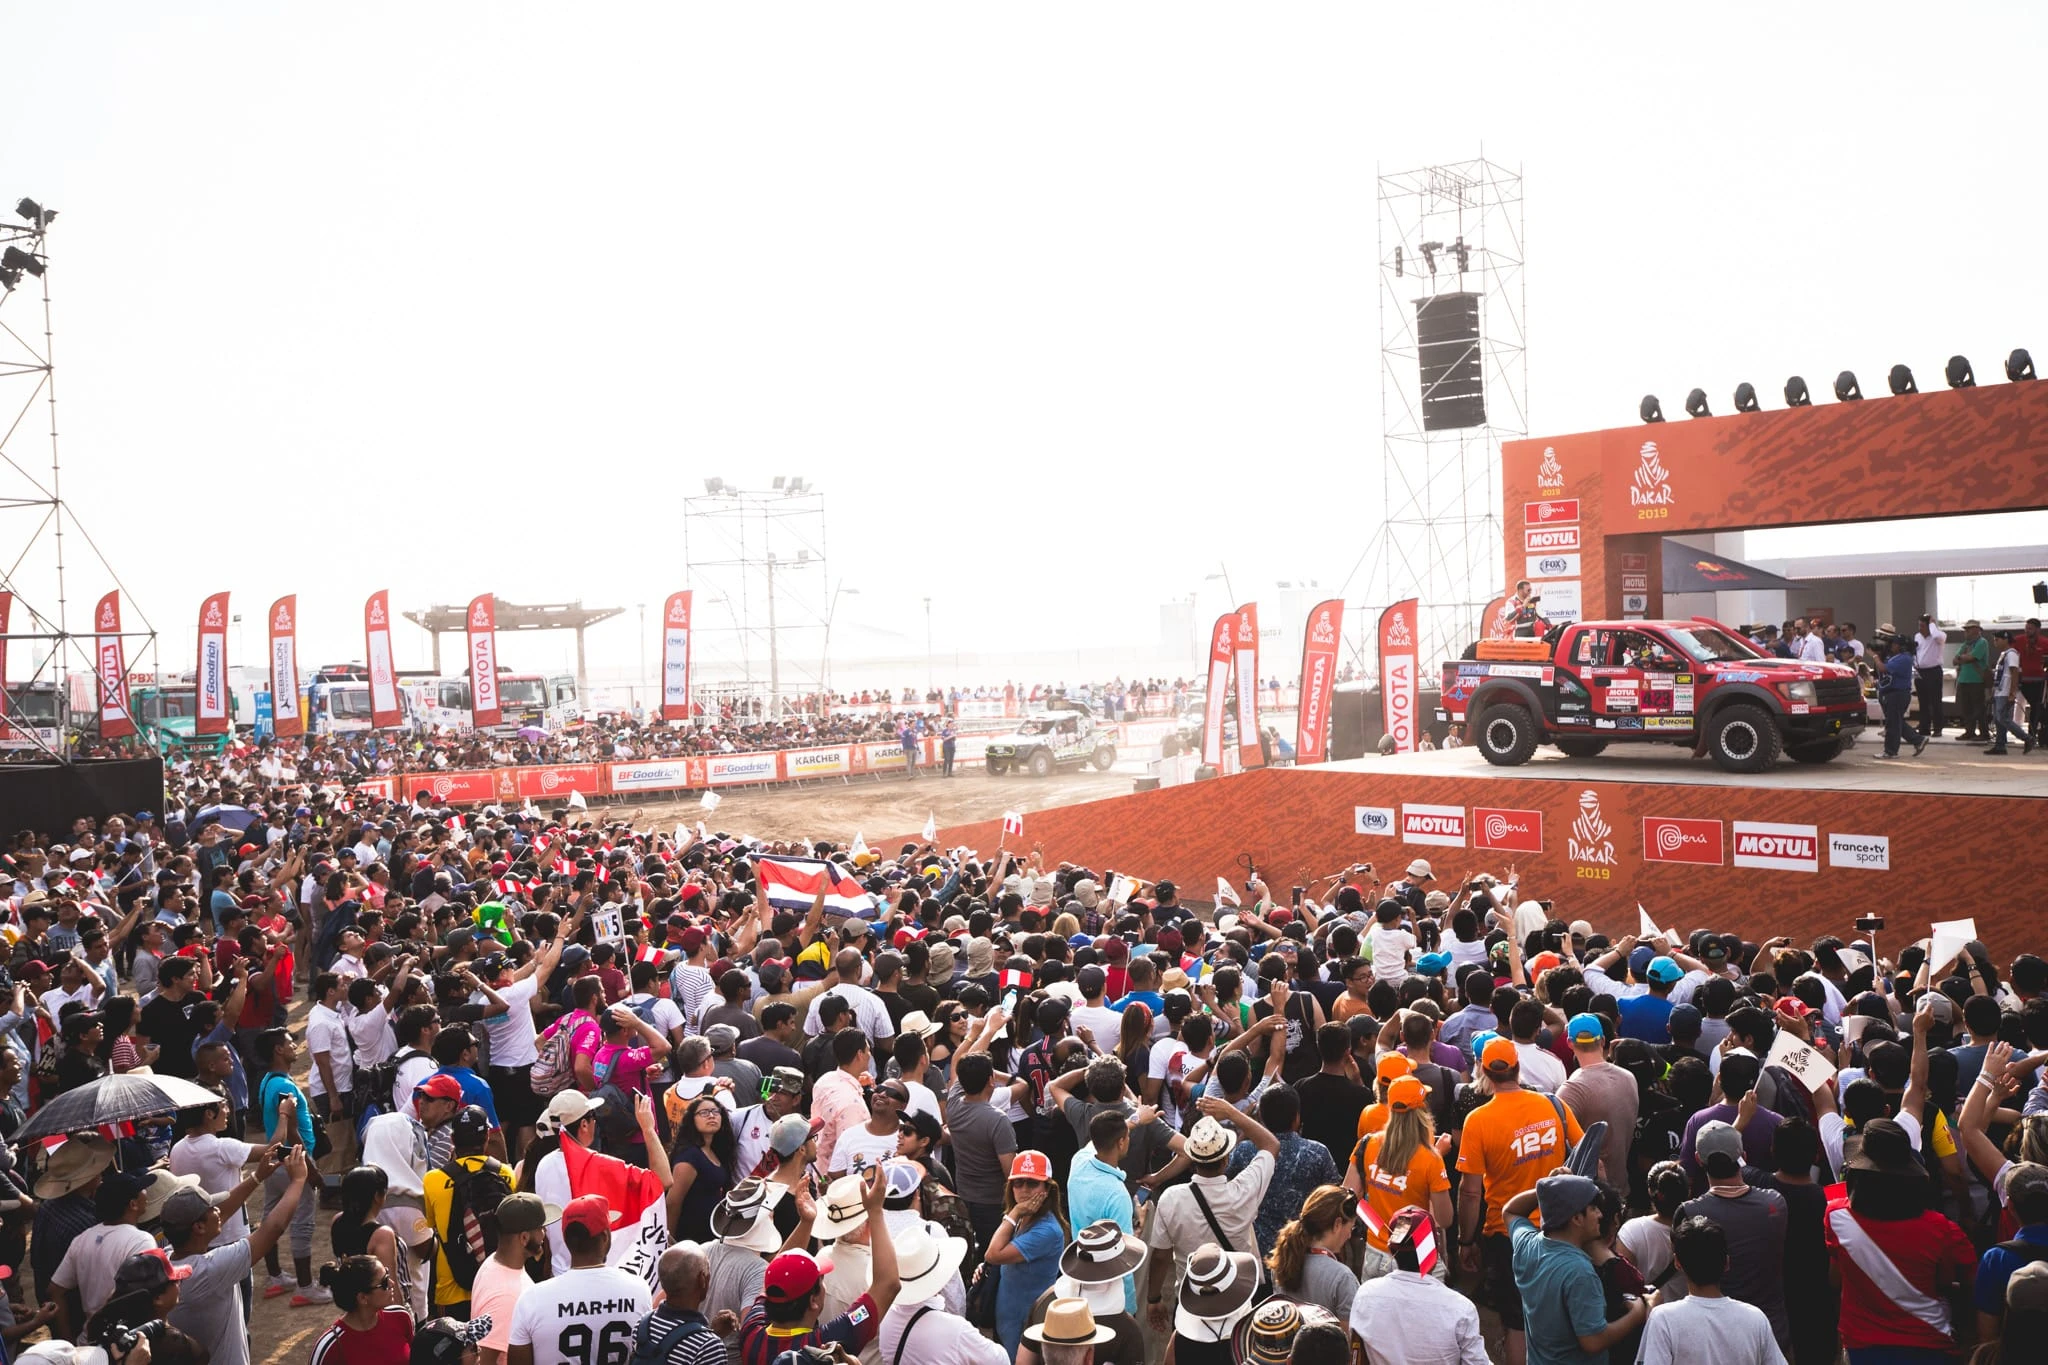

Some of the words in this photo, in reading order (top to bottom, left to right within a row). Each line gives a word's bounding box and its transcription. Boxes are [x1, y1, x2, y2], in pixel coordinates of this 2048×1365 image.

[1538, 473, 1565, 488] DAKAR
[1542, 488, 1561, 497] 2019
[1630, 484, 1675, 506] DAKAR
[1637, 508, 1668, 520] 2019
[1530, 532, 1576, 547] MOTUL
[1624, 578, 1646, 589] MOTUL
[1312, 632, 1335, 645] DAKAR
[1387, 636, 1412, 648] DAKAR
[129, 673, 154, 683] PBX
[206, 641, 217, 711] BFGoodrich
[476, 639, 491, 705] TOYOTA
[1308, 656, 1326, 731] HONDA
[1643, 690, 1671, 708] 423
[460, 726, 473, 735] 515
[874, 747, 904, 758] KARCH
[618, 768, 680, 780] BFGoodrich
[713, 761, 772, 774] BFGoodrich
[1367, 814, 1382, 824] FOX
[1407, 816, 1461, 834] MOTUL
[1484, 814, 1528, 845] Perú
[1656, 824, 1707, 857] Perú
[1739, 836, 1812, 857] MOTUL
[1568, 838, 1618, 865] DAKAR
[1856, 852, 1885, 864] sport
[1576, 866, 1610, 880] 2019
[1780, 1054, 1806, 1076] DAKAR
[1510, 1126, 1558, 1158] 124
[558, 1320, 633, 1365] 96
